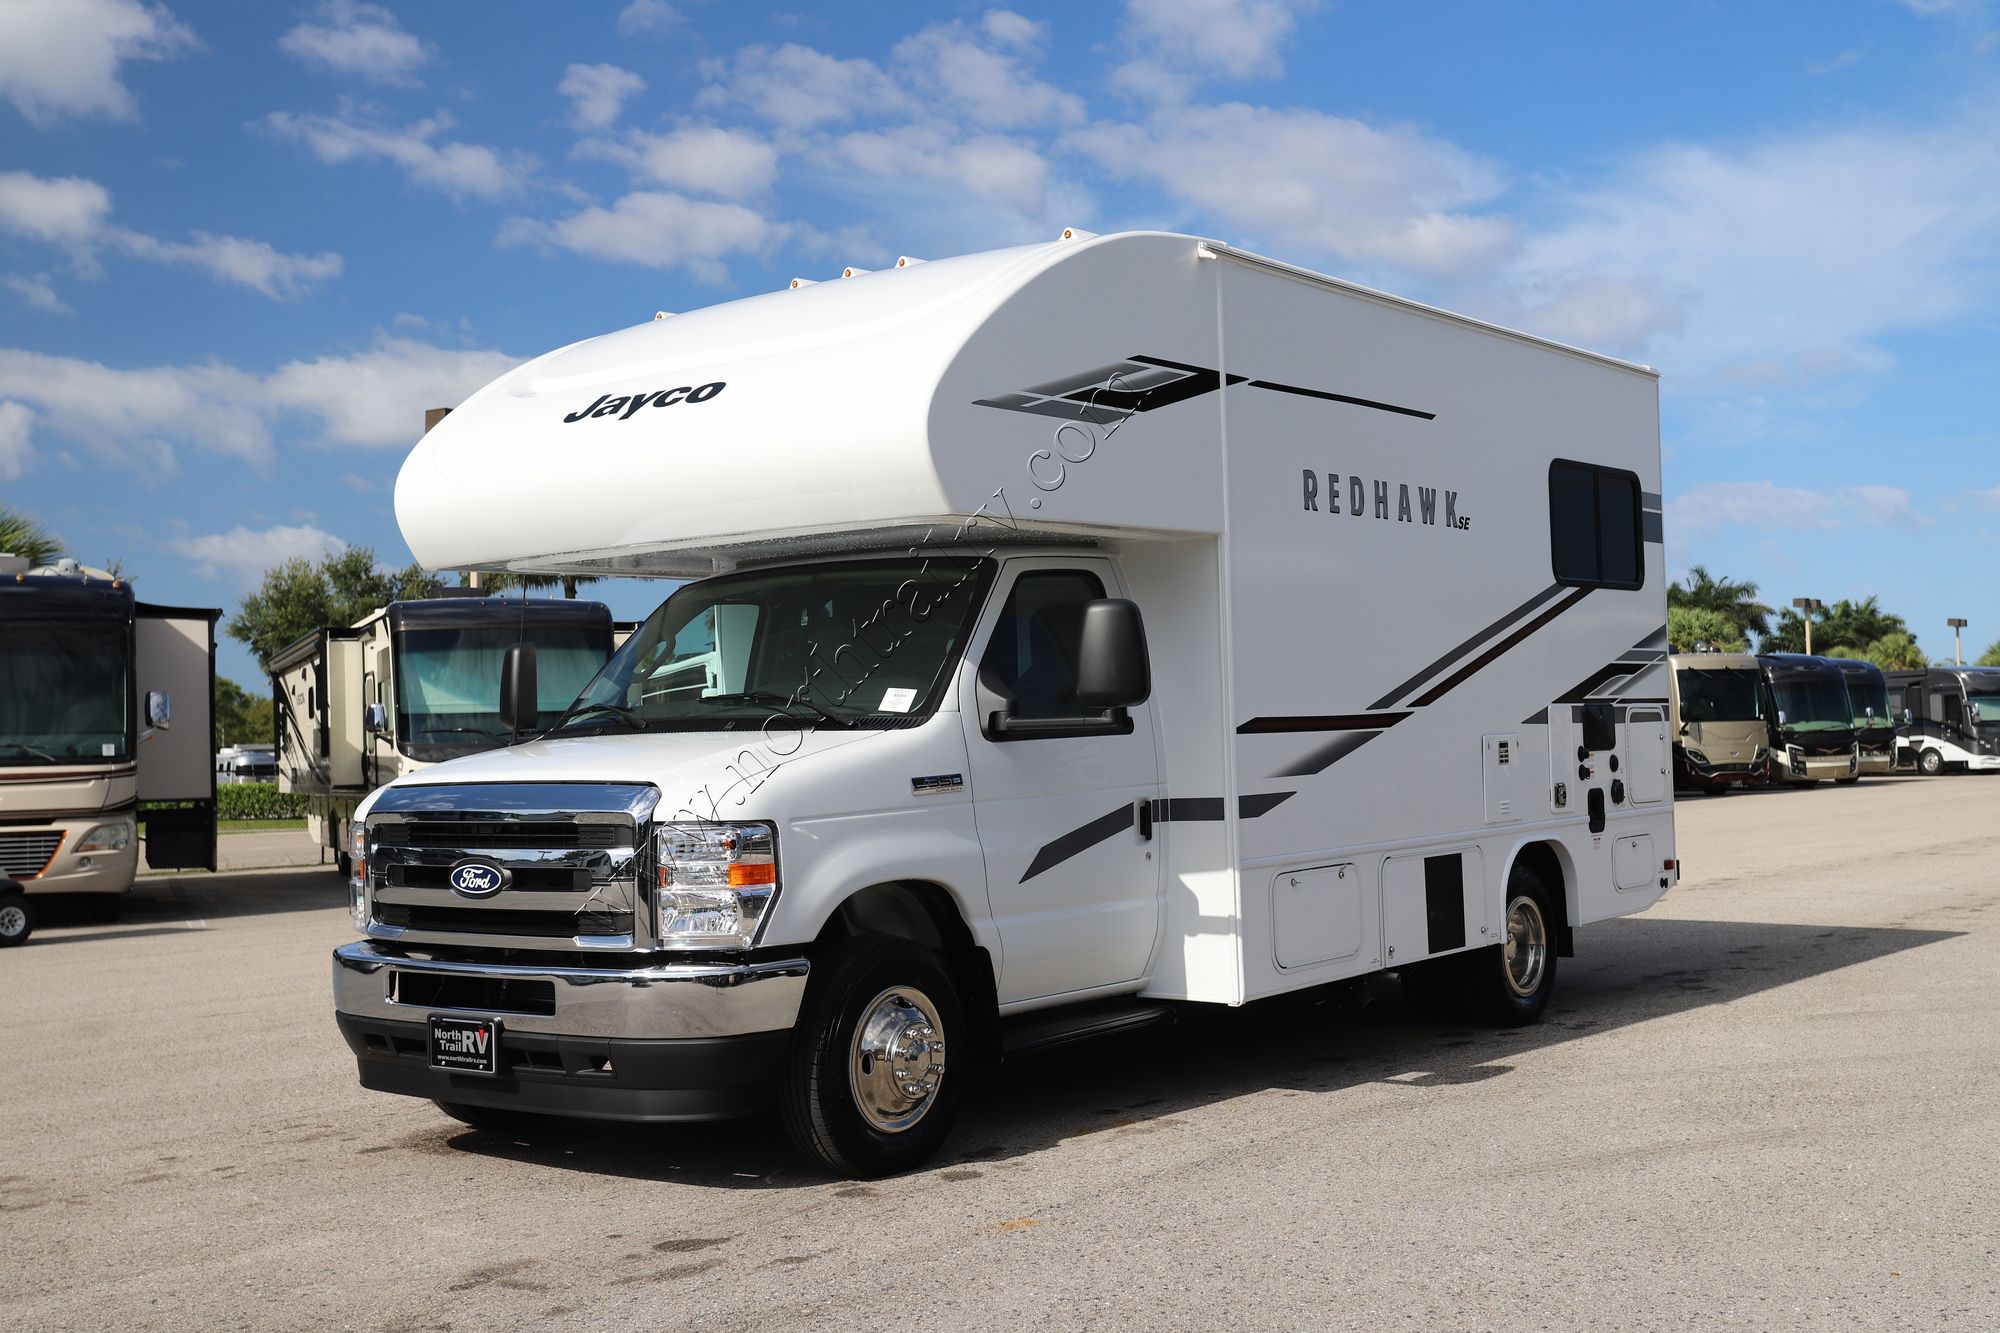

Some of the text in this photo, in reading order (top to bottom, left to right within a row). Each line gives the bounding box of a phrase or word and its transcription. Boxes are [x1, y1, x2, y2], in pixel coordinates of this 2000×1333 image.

[563, 382, 727, 424] Jayco
[1303, 469, 1471, 530] REDHAWK SE
[460, 868, 491, 888] Ford
[434, 1028, 461, 1040] North
[462, 1029, 488, 1054] RV
[440, 1040, 461, 1052] Trail
[437, 1055, 487, 1064] www.northtrailrv.com
